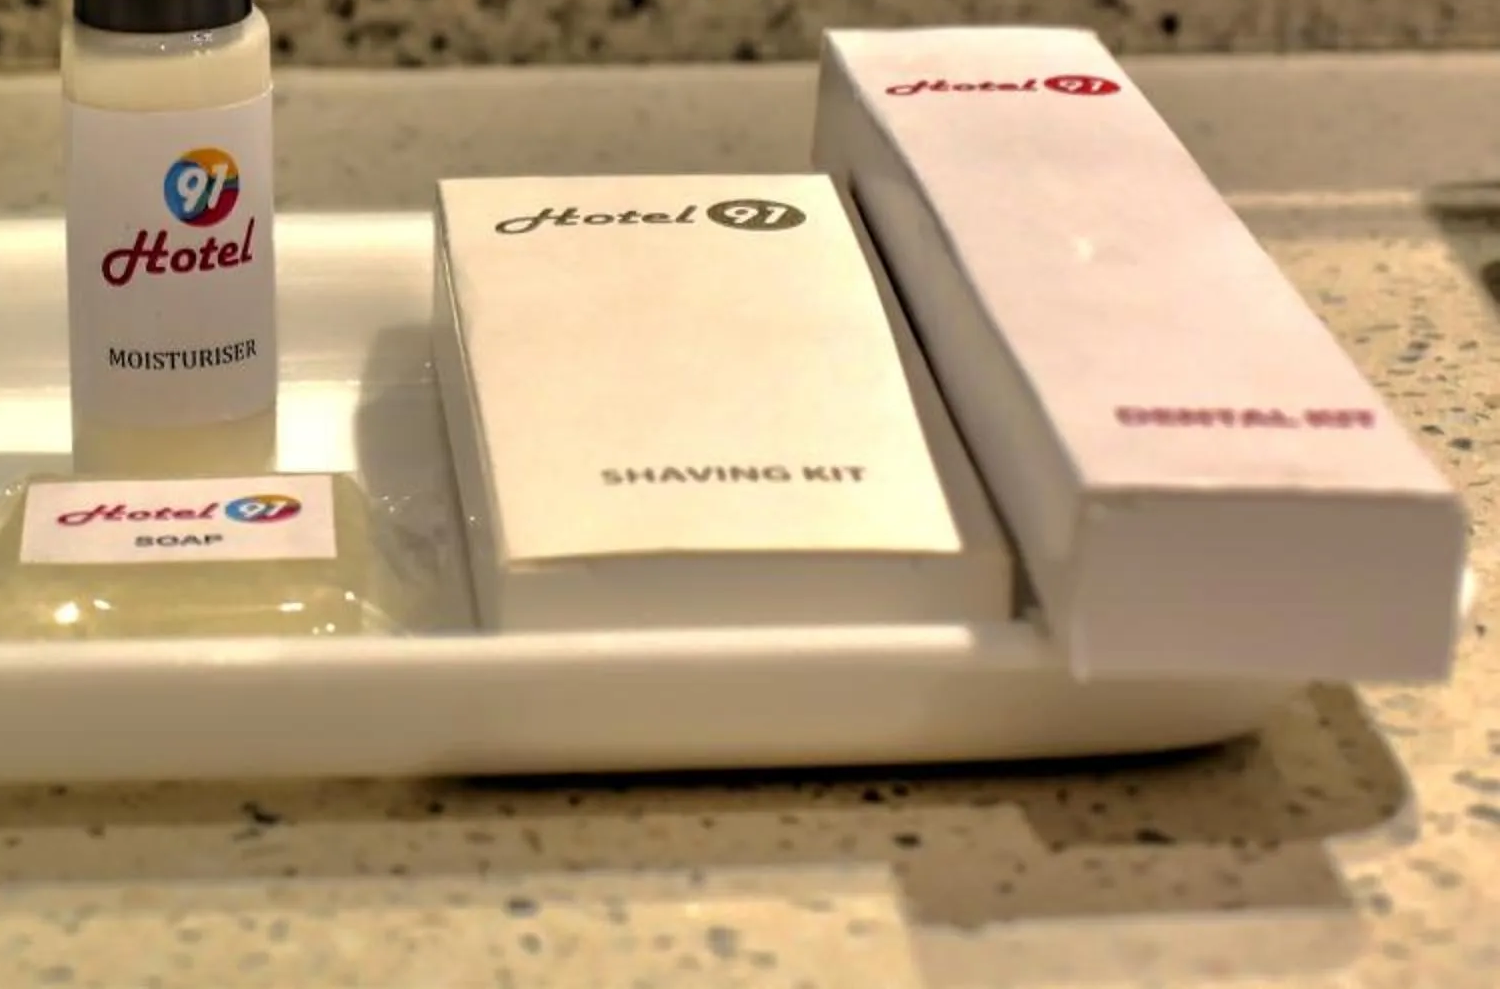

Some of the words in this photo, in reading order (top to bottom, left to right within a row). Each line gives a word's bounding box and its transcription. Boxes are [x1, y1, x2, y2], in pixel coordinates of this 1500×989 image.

[1054, 77, 1106, 94] 91
[173, 159, 232, 216] 91
[495, 204, 698, 235] Hotel
[719, 203, 792, 227] 91
[101, 217, 255, 286] Hotel
[108, 339, 257, 370] MOISTURISER
[600, 465, 792, 486] SHAVING
[802, 465, 866, 483] KIT
[56, 502, 220, 527] Hotel
[236, 498, 290, 521] 91
[134, 534, 223, 547] SOAP
